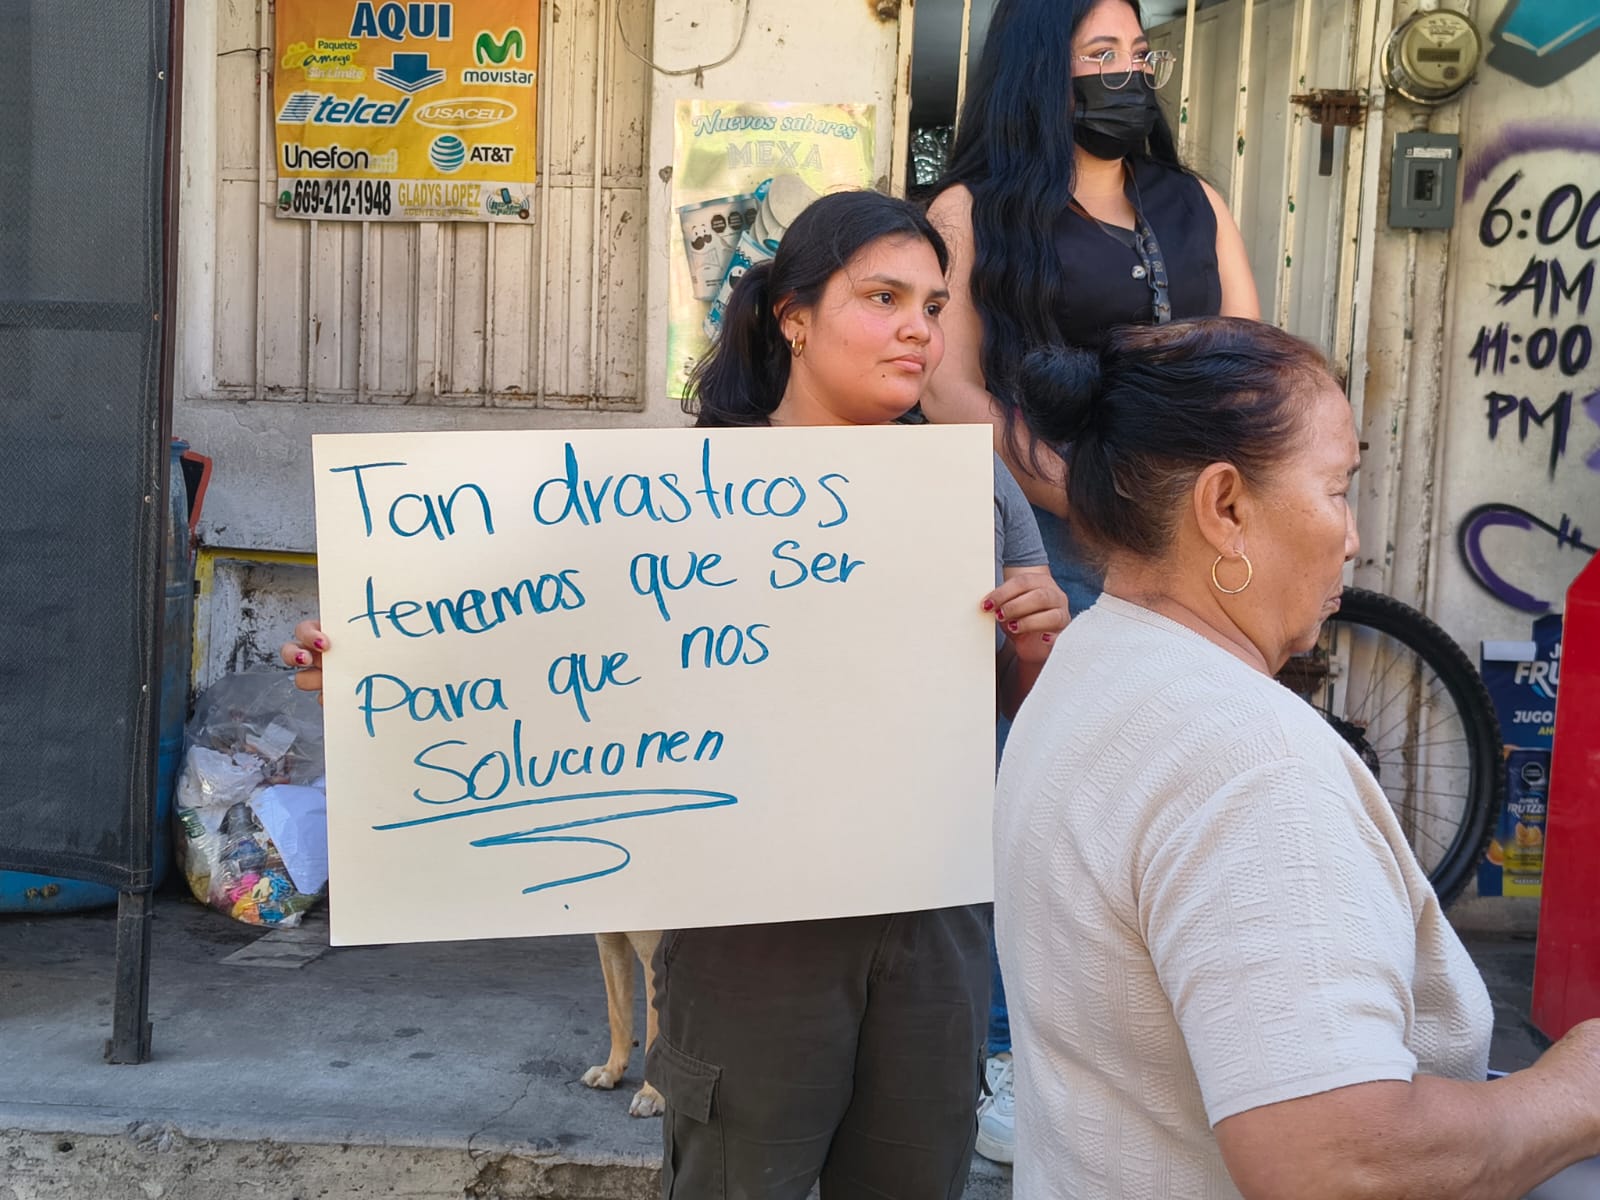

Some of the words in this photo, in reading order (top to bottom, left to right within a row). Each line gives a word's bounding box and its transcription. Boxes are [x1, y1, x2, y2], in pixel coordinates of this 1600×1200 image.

[349, 1, 452, 41] AQUI
[318, 40, 358, 51] Paquetes
[464, 70, 534, 84] movistar
[314, 96, 411, 124] telcel
[692, 109, 777, 136] Nuevos
[781, 113, 858, 140] sabores
[285, 144, 369, 169] Unefon
[470, 146, 514, 162] AT&T
[727, 141, 824, 170] MEXA
[293, 180, 391, 216] 669-212-1948
[398, 183, 442, 207] GLADYS
[1488, 254, 1595, 318] AM
[1468, 321, 1593, 377] 11:00
[1484, 391, 1574, 482] PM
[329, 462, 495, 540] Tan
[533, 438, 849, 528] drasticos
[348, 569, 586, 638] tenemos
[630, 551, 737, 621] que
[548, 652, 641, 722] que
[681, 624, 770, 668] nos
[1513, 710, 1553, 723] JUGO
